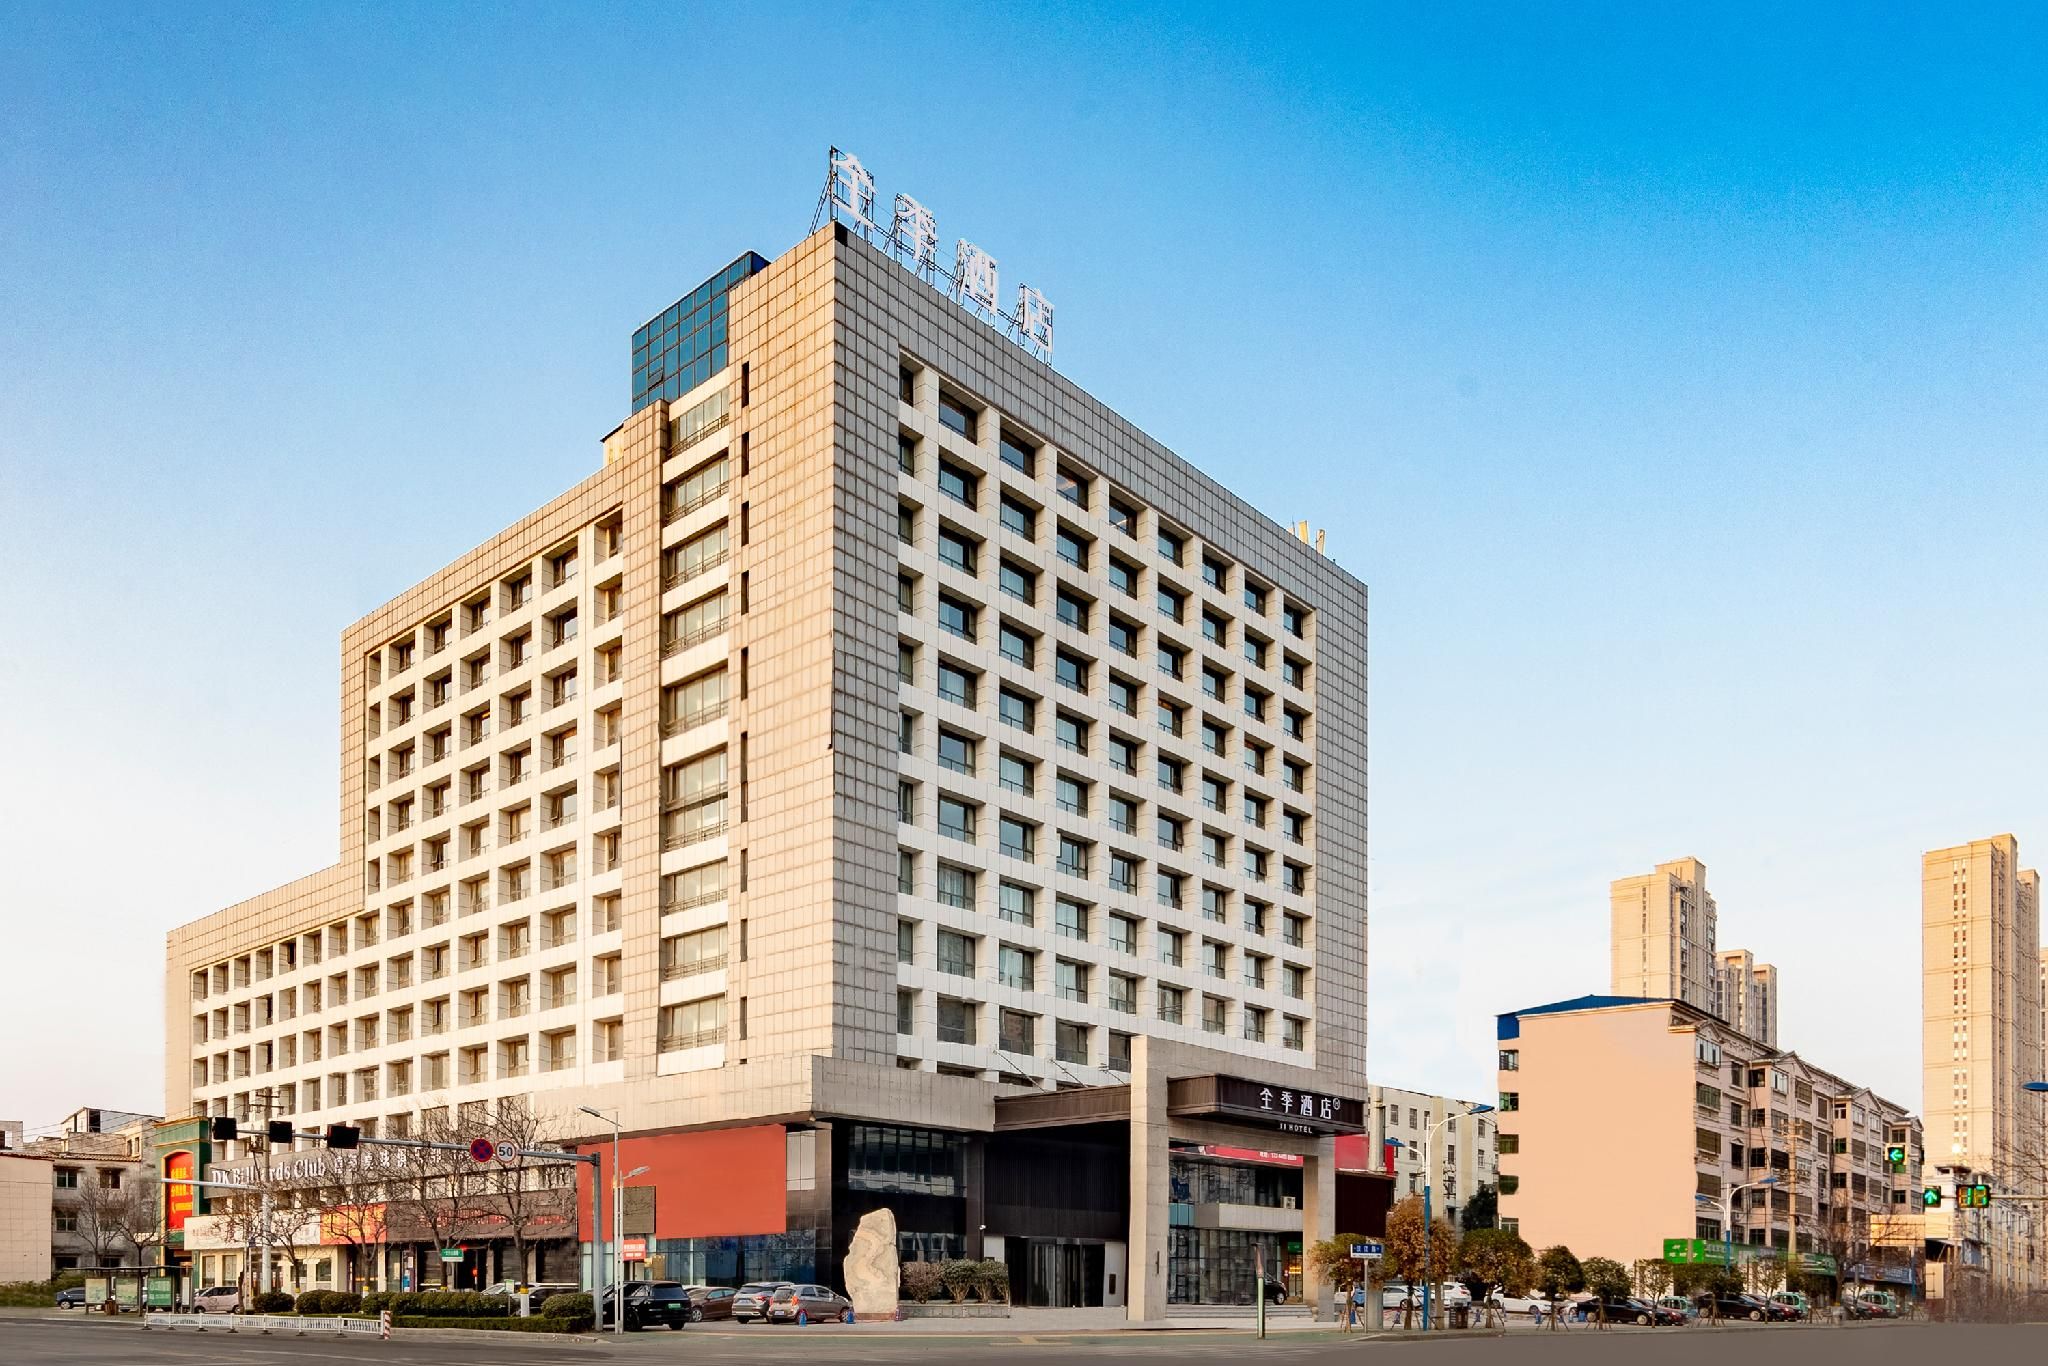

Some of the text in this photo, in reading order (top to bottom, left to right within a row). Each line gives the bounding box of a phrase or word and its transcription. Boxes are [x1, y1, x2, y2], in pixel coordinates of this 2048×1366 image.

[830, 152, 1055, 353] 全季酒店
[1260, 1087, 1332, 1119] 全季酒店
[1289, 1123, 1313, 1134] HOTEL
[498, 1146, 513, 1157] 50
[211, 1168, 230, 1184] DK
[294, 1157, 327, 1179] Club
